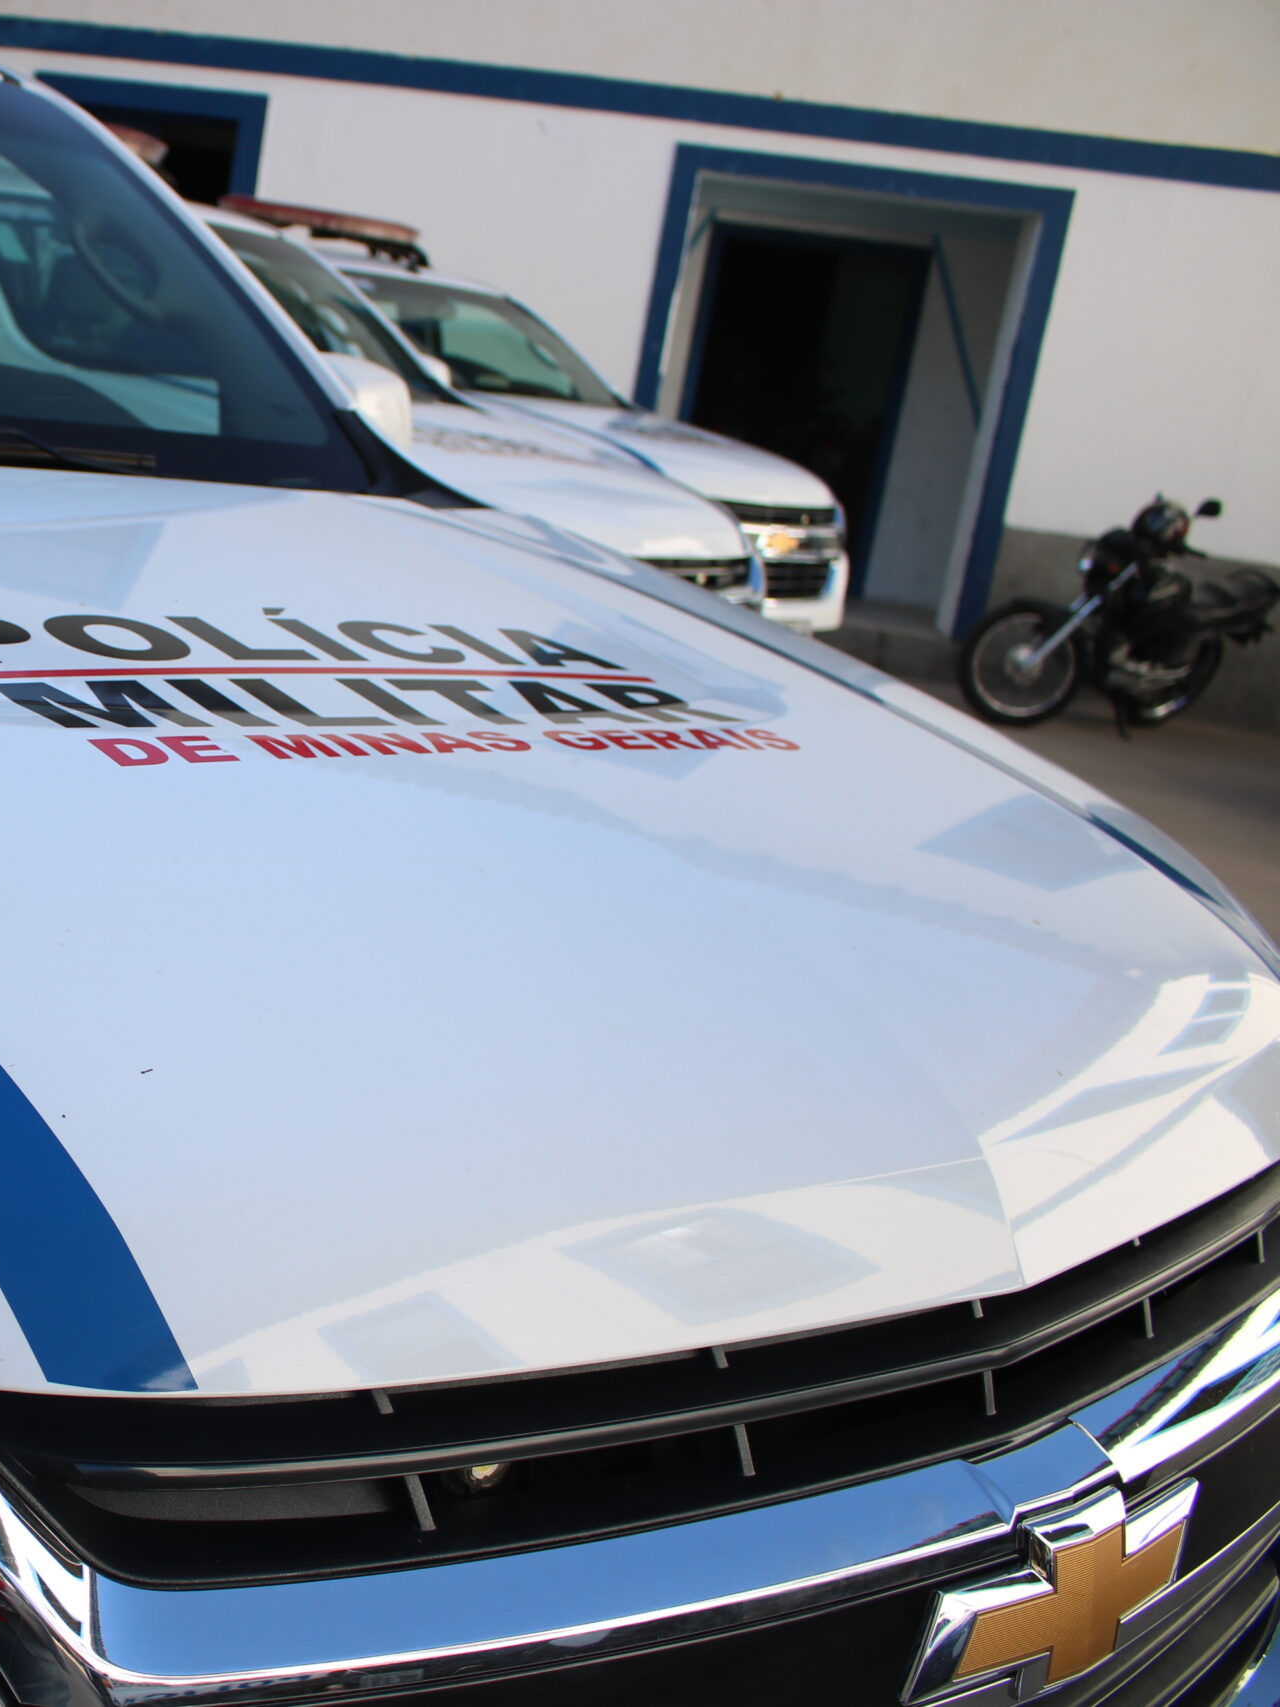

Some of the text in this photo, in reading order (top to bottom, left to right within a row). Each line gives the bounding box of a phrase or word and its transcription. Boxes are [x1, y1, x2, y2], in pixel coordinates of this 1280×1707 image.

[86, 729, 801, 767] DE MINAS GERAIS
